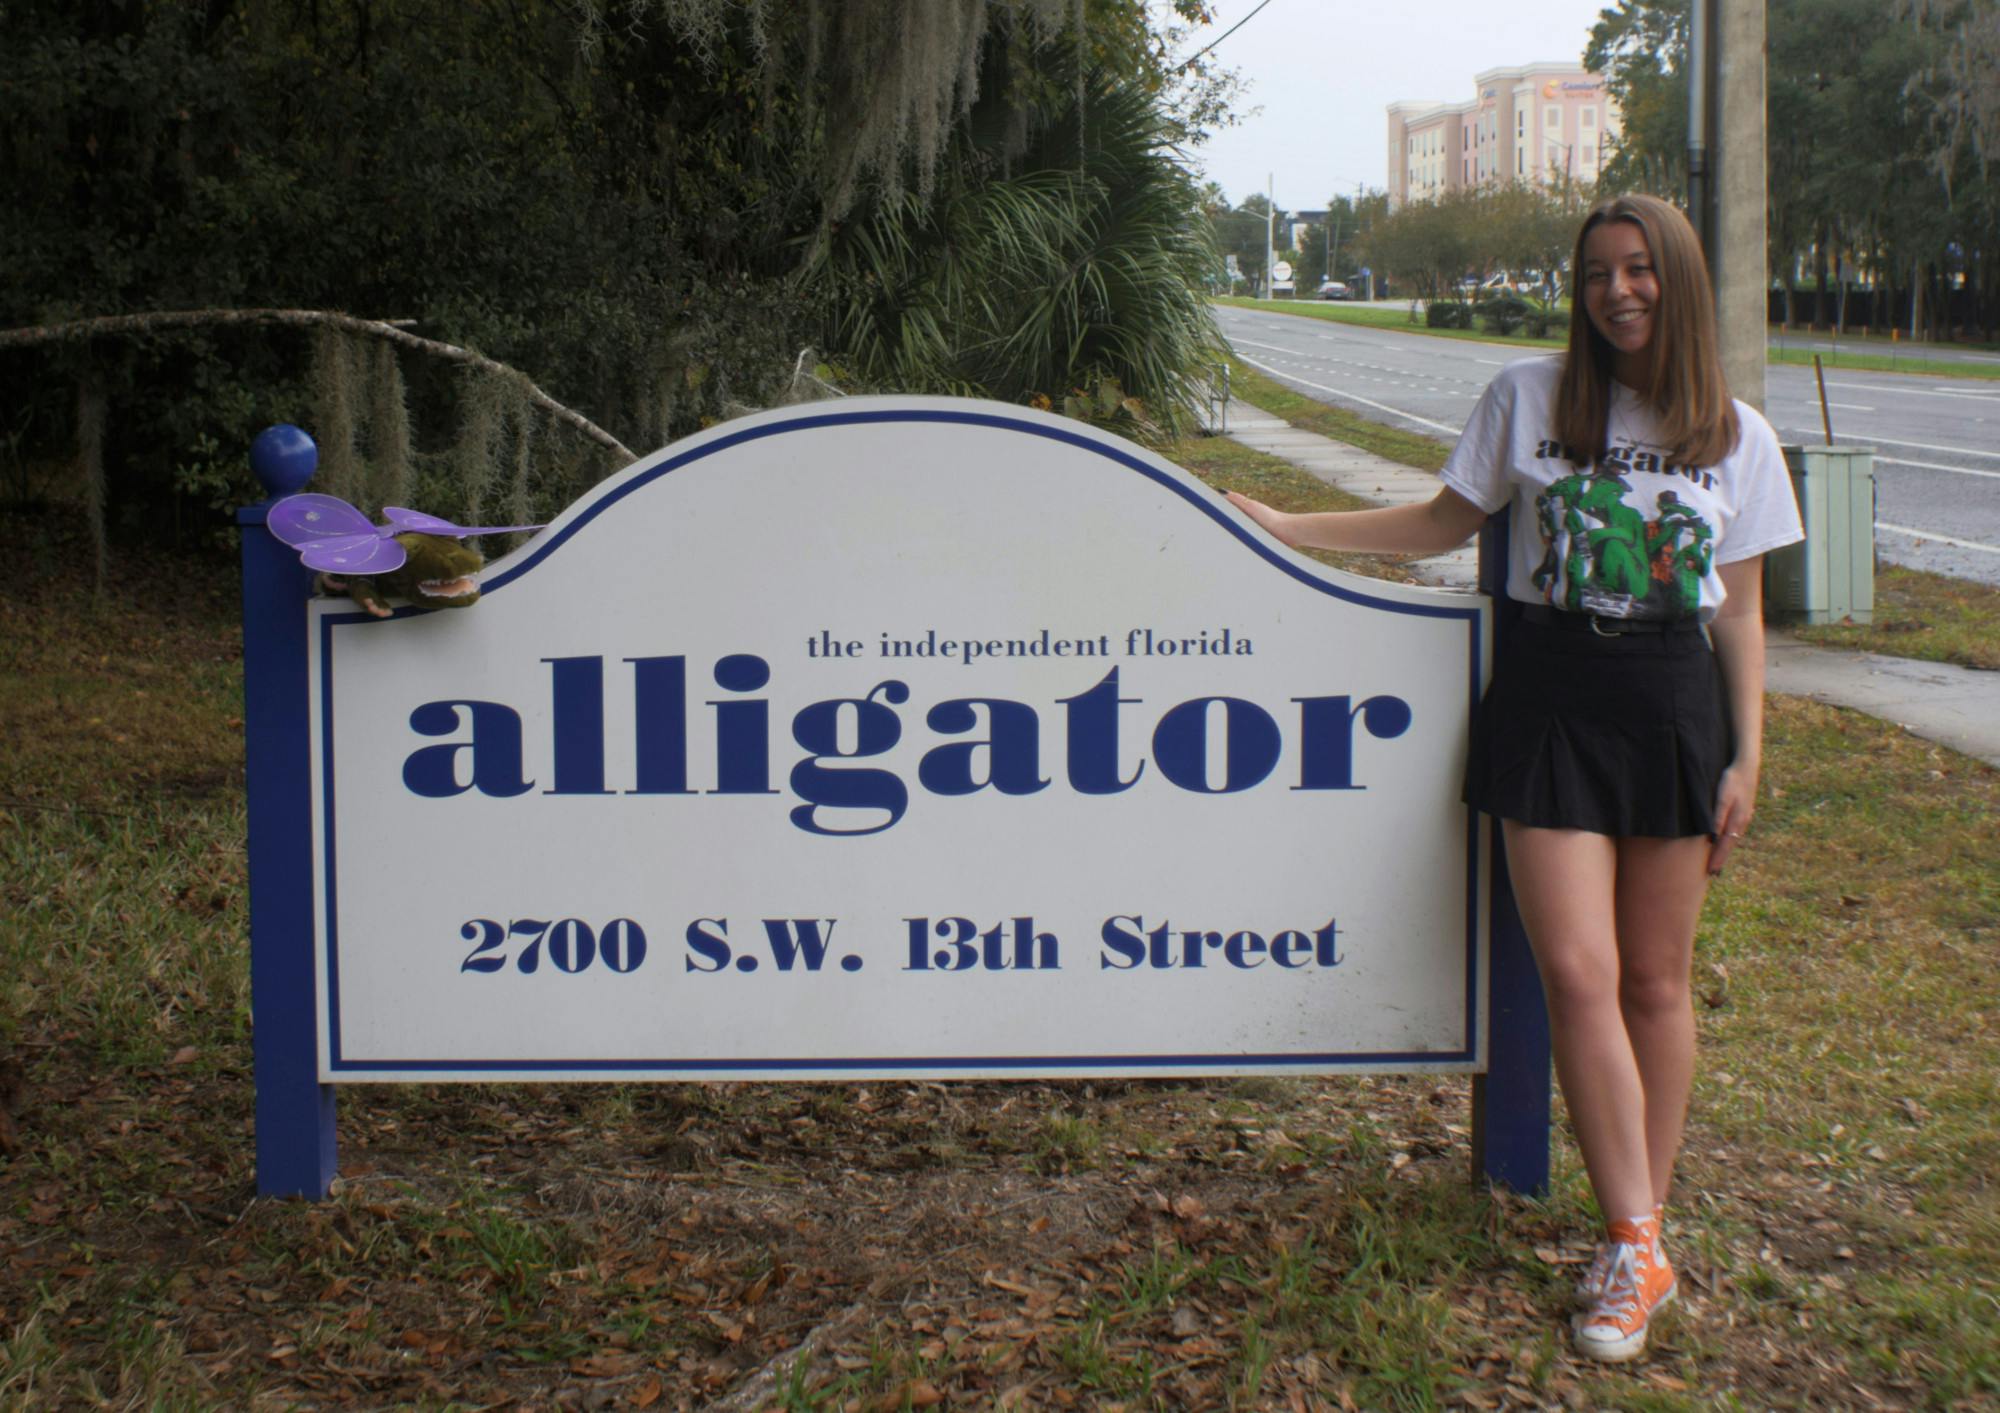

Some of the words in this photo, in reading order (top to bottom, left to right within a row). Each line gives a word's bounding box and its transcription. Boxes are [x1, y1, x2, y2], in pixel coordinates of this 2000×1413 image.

[808, 630, 863, 658] the
[881, 629, 1109, 664] independent
[1126, 628, 1253, 656] florida
[402, 653, 1412, 837] alligator
[460, 918, 648, 975] 2700
[685, 918, 864, 973] S.W.
[901, 916, 1062, 971] 13th
[1100, 915, 1345, 970] Street
